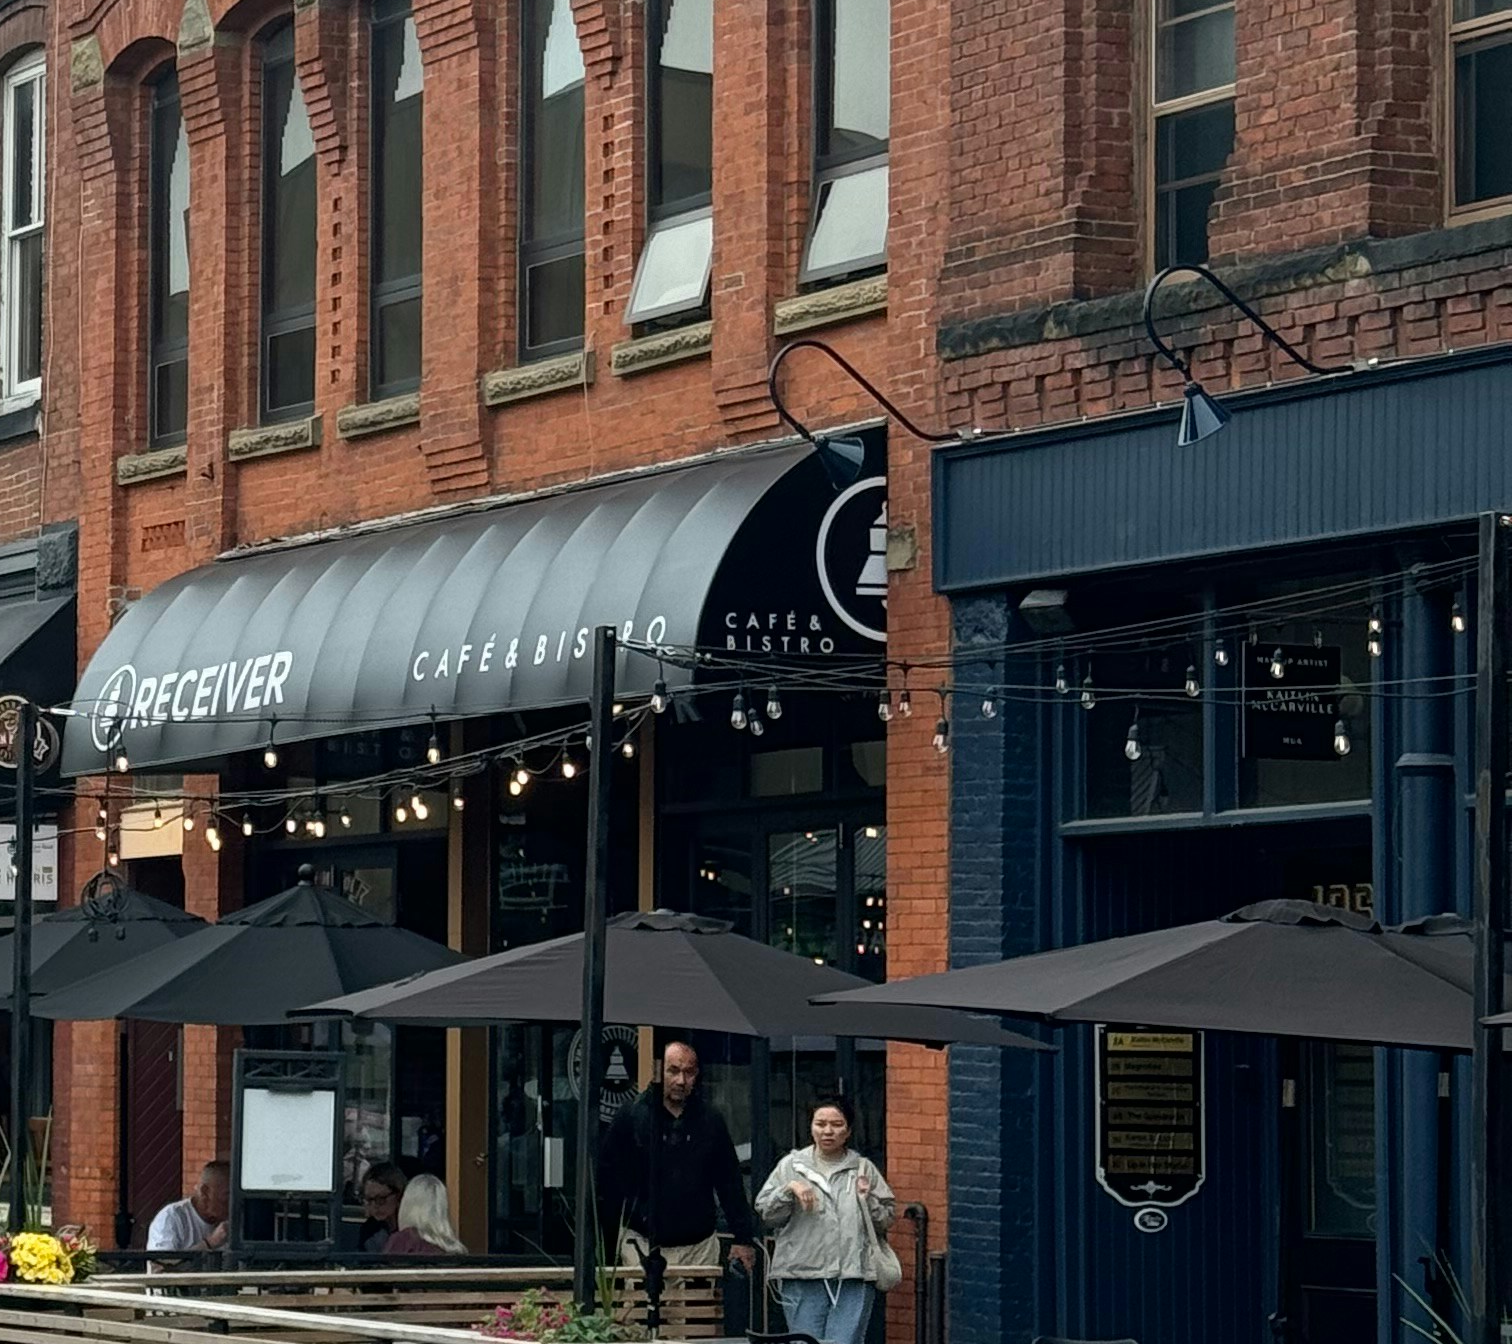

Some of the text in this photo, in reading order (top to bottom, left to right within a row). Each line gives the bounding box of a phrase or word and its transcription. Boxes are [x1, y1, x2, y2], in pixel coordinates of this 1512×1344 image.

[725, 610, 822, 631] CAFÉ &
[412, 615, 666, 681] CAFÉ & BISRO
[726, 635, 834, 654] BISTRO
[130, 650, 294, 730] RECEIVER
